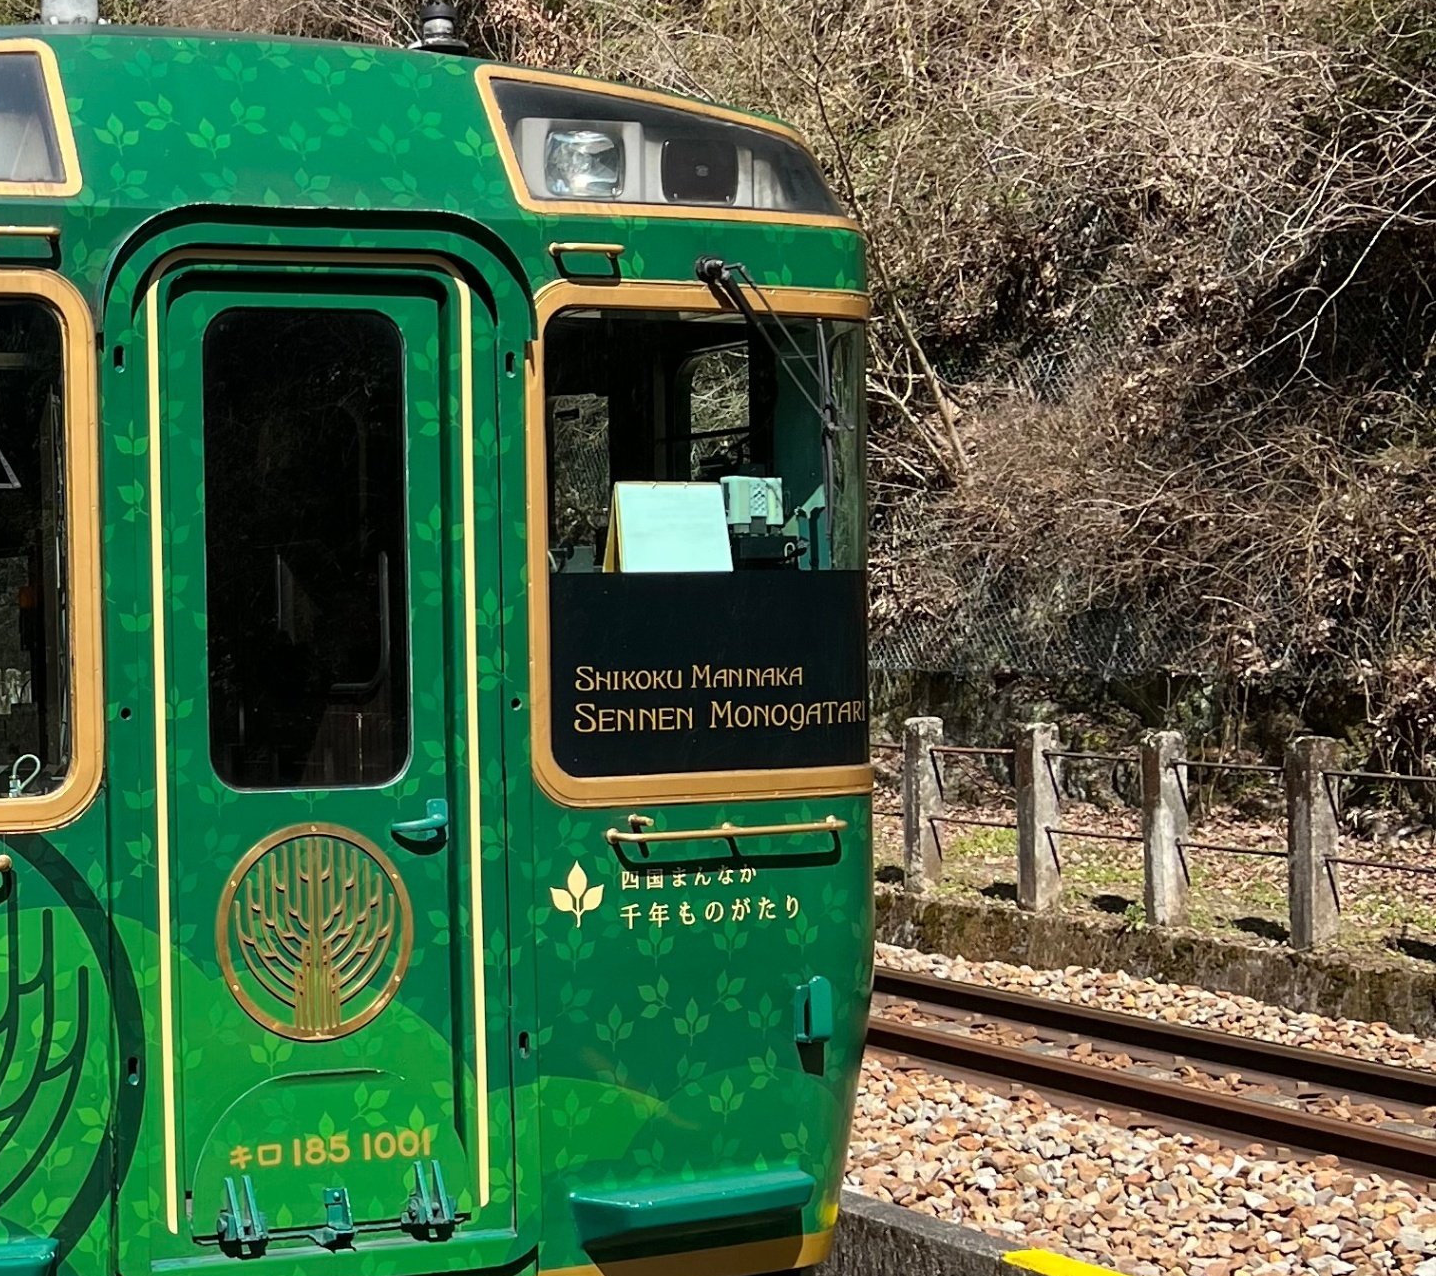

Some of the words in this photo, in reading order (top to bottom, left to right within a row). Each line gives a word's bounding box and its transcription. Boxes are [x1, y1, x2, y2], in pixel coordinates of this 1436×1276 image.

[574, 665, 683, 692] SHIKOKU
[690, 664, 804, 690] MANNAKA
[573, 702, 694, 733] SENNEN
[620, 865, 757, 891] 四国まんなか
[619, 894, 800, 930] 千年ものがたり
[293, 1134, 351, 1166] 185
[363, 1128, 431, 1161] 1001
